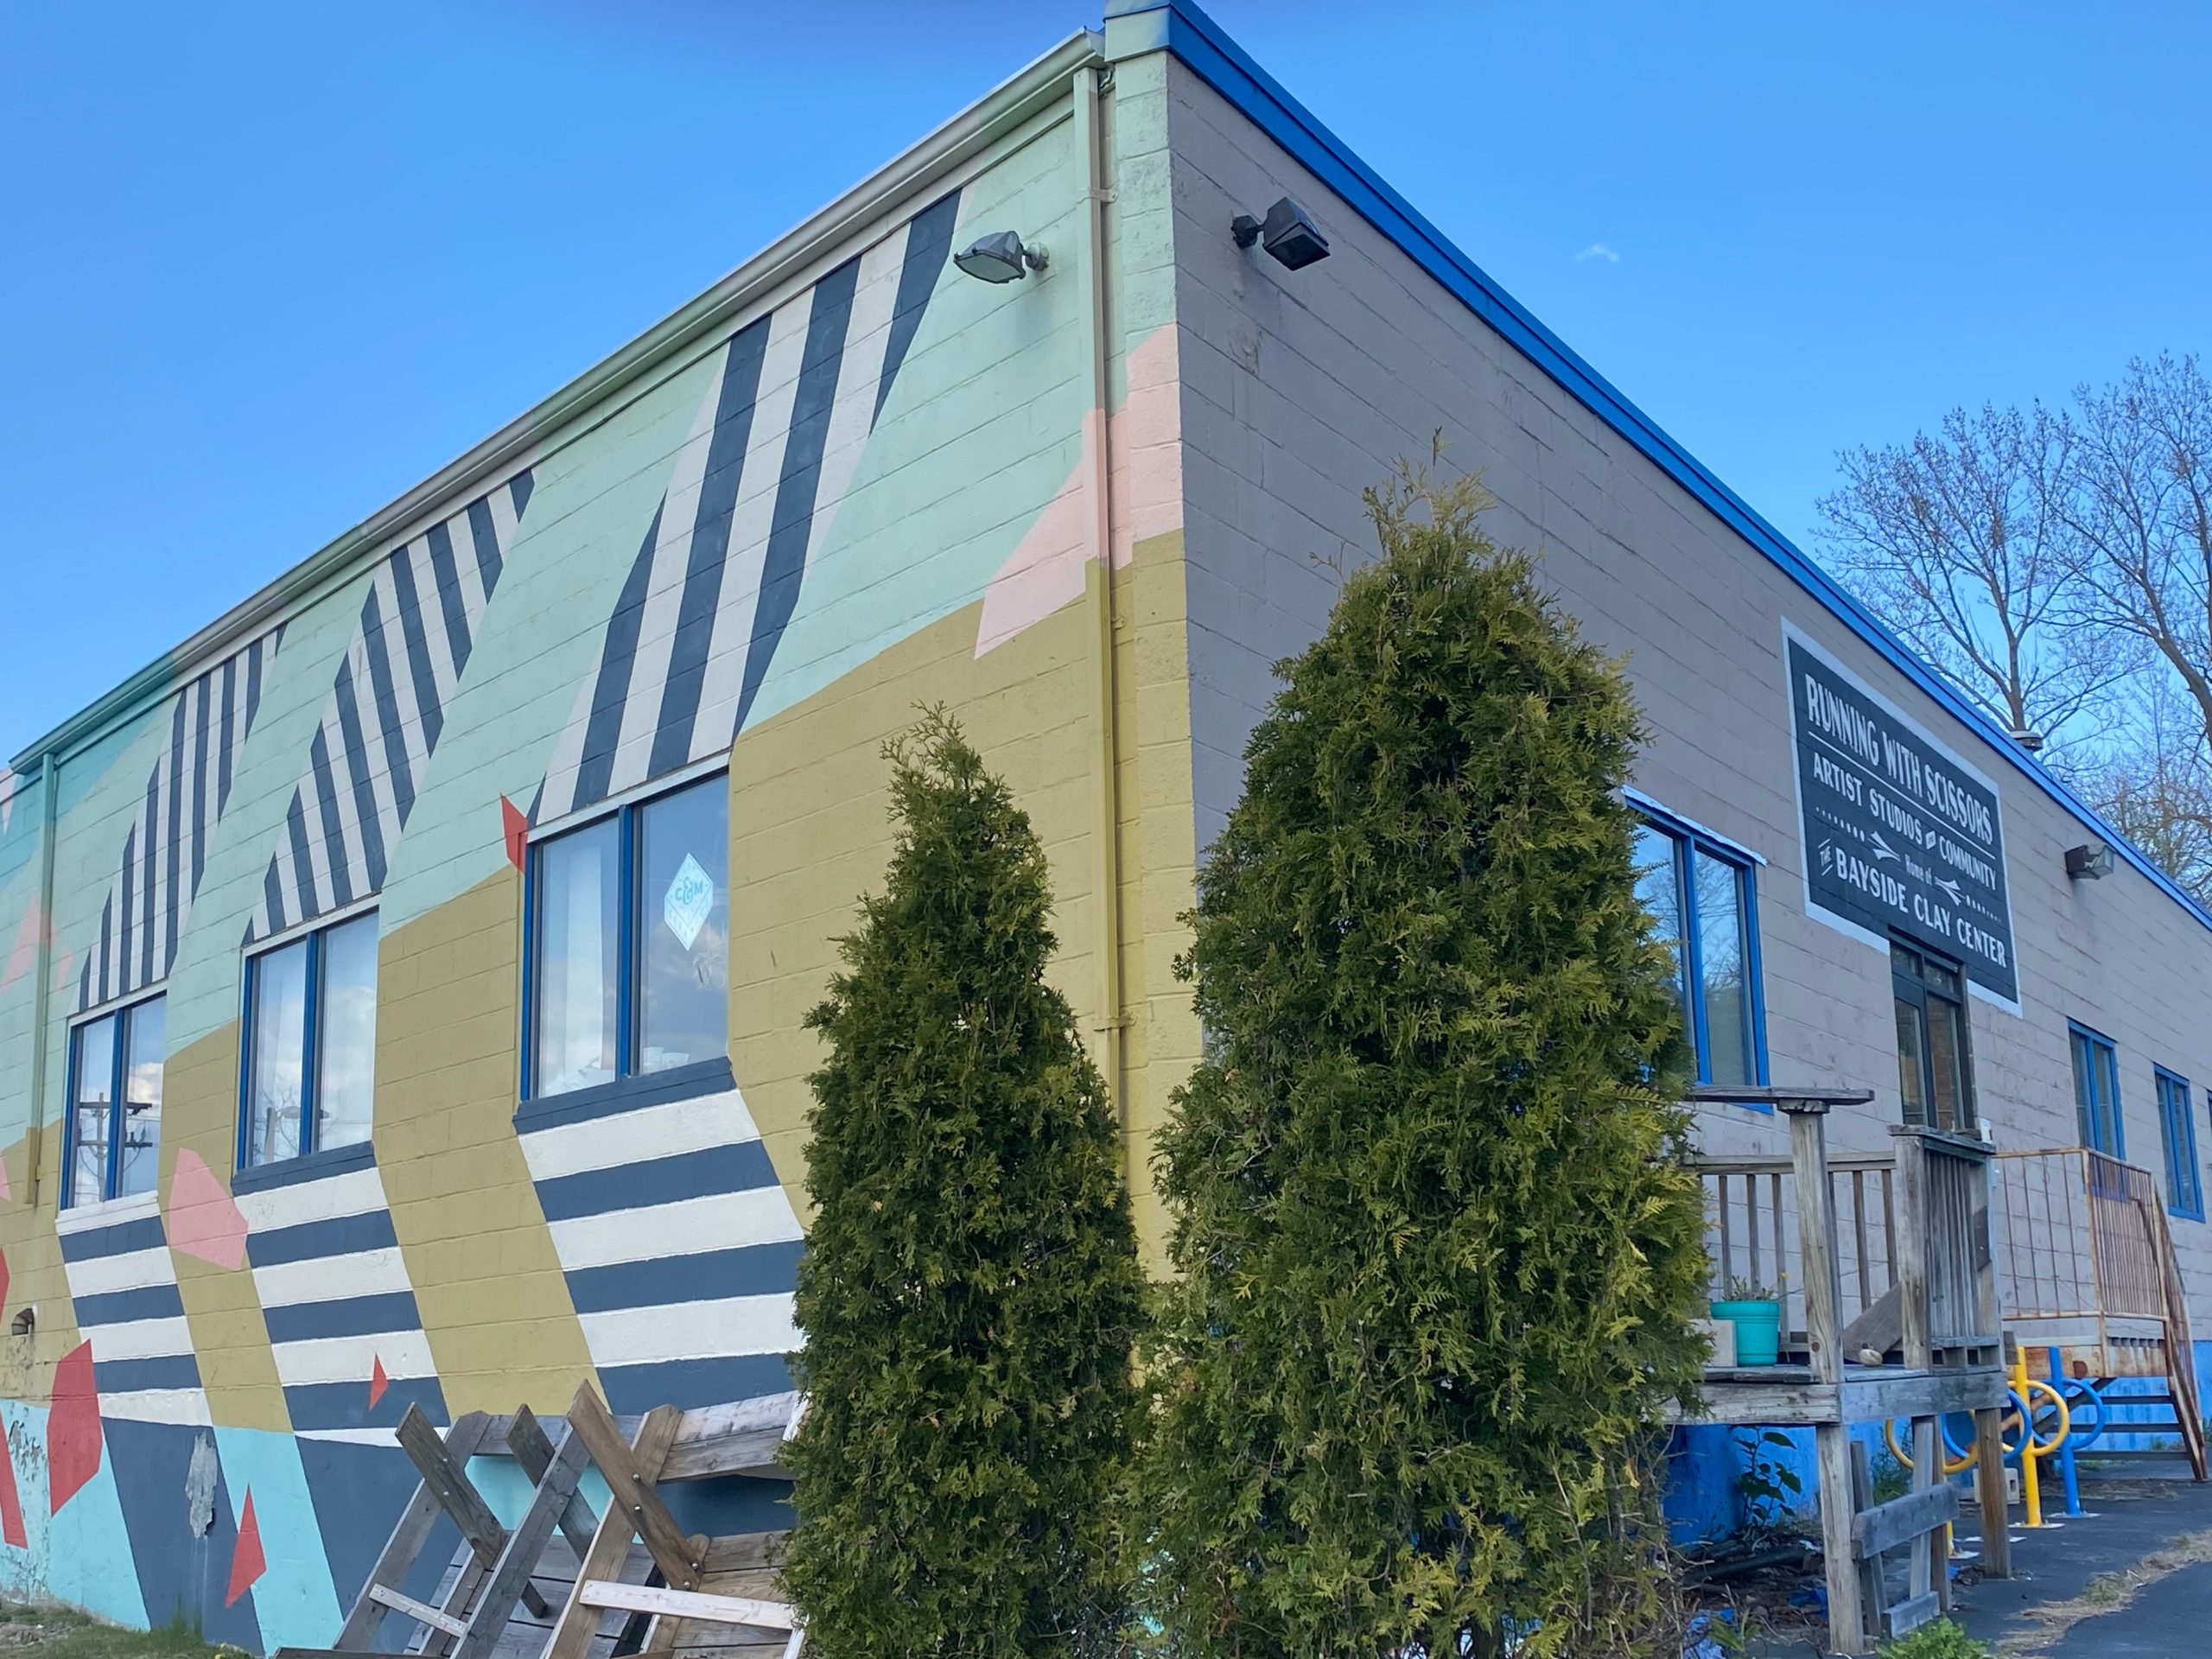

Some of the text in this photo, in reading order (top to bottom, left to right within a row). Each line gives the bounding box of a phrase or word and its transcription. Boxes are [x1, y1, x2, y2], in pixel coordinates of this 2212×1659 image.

[1805, 673, 1993, 846] RUNNING WITH SCISSORS
[1814, 752, 1996, 891] ARTIST STUDIOS COMMUNITY
[1835, 847, 1909, 913] BAYSIDE
[1914, 893, 1951, 938] CLAY
[1956, 917, 2007, 969] CENTER
